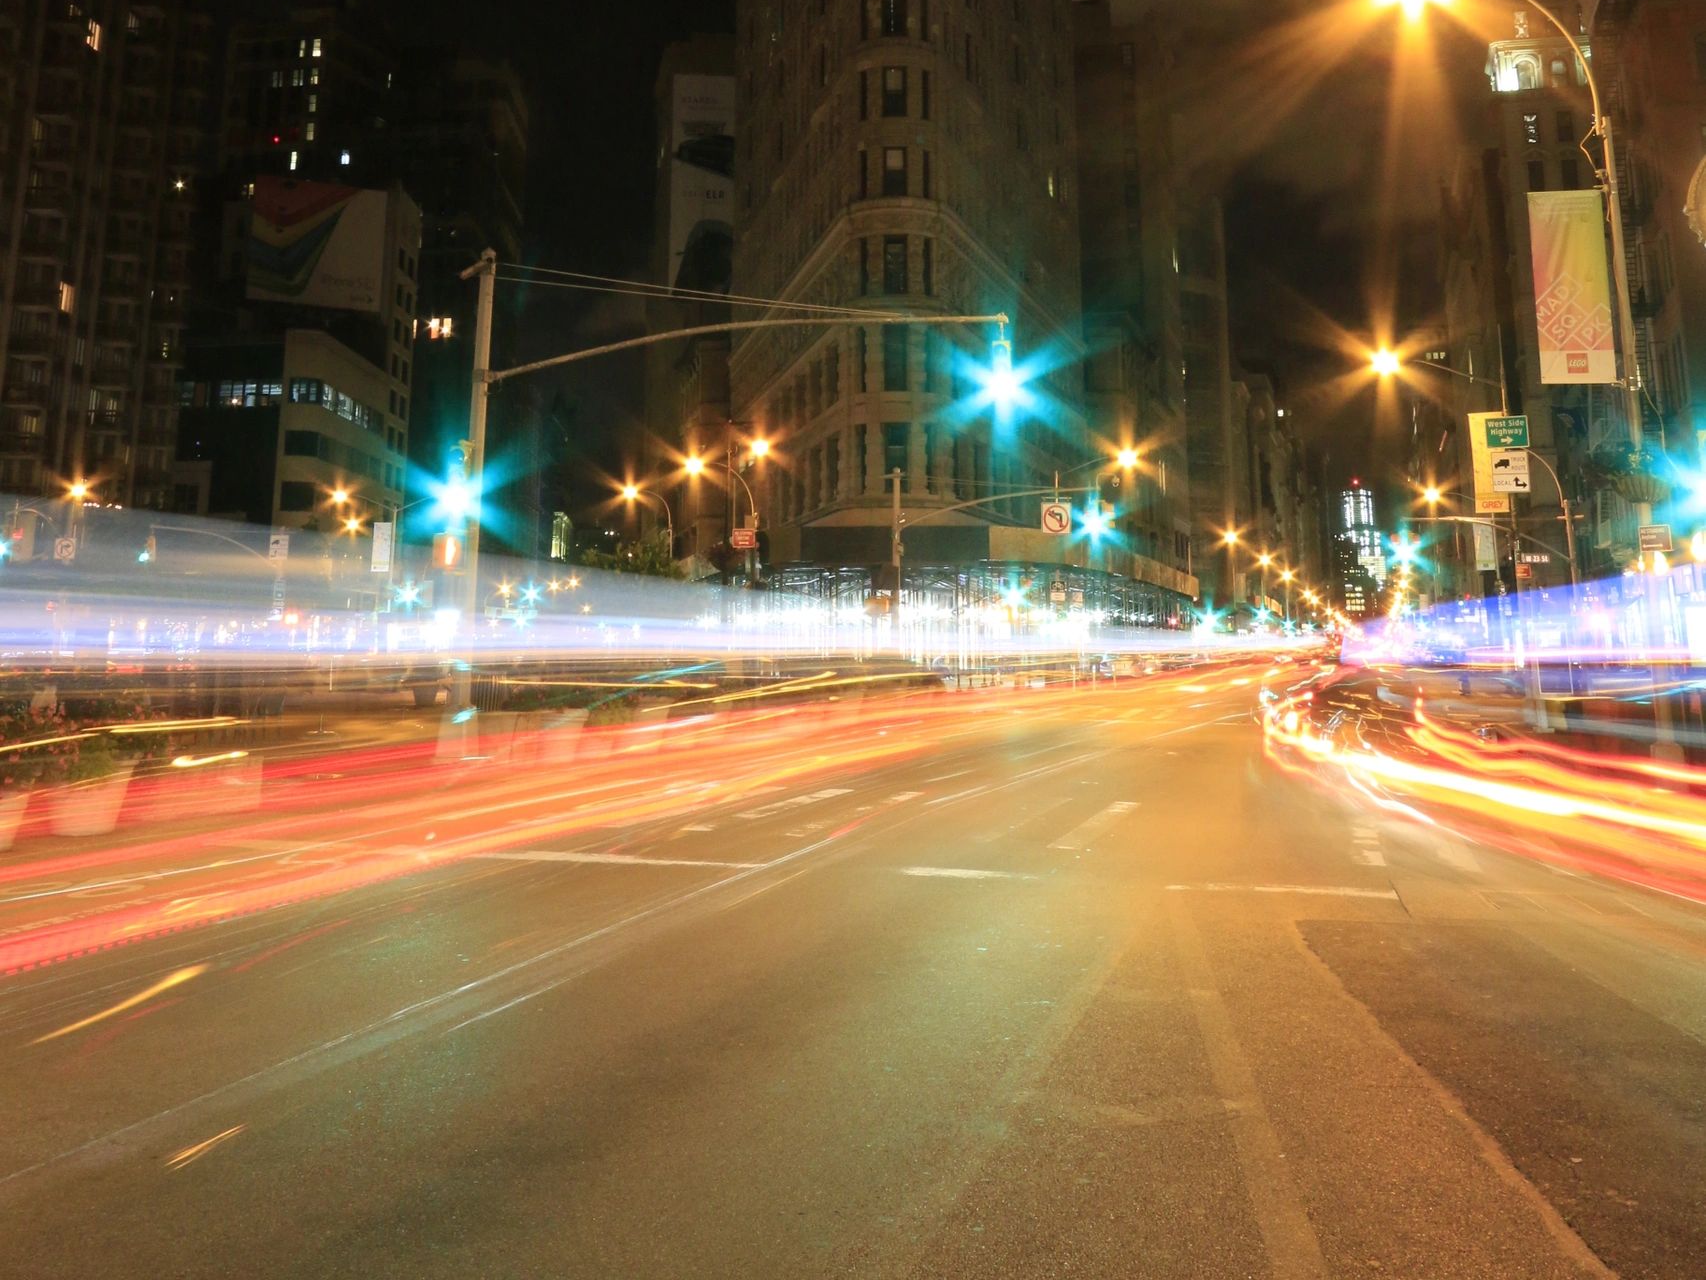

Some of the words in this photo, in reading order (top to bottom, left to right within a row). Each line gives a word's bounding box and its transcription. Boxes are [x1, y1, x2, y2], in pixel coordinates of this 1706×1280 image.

[1552, 313, 1582, 339] SQ.
[1568, 359, 1586, 367] LEGO
[1487, 420, 1506, 428] West
[1490, 428, 1523, 436] Highway
[1482, 501, 1504, 509] GREY
